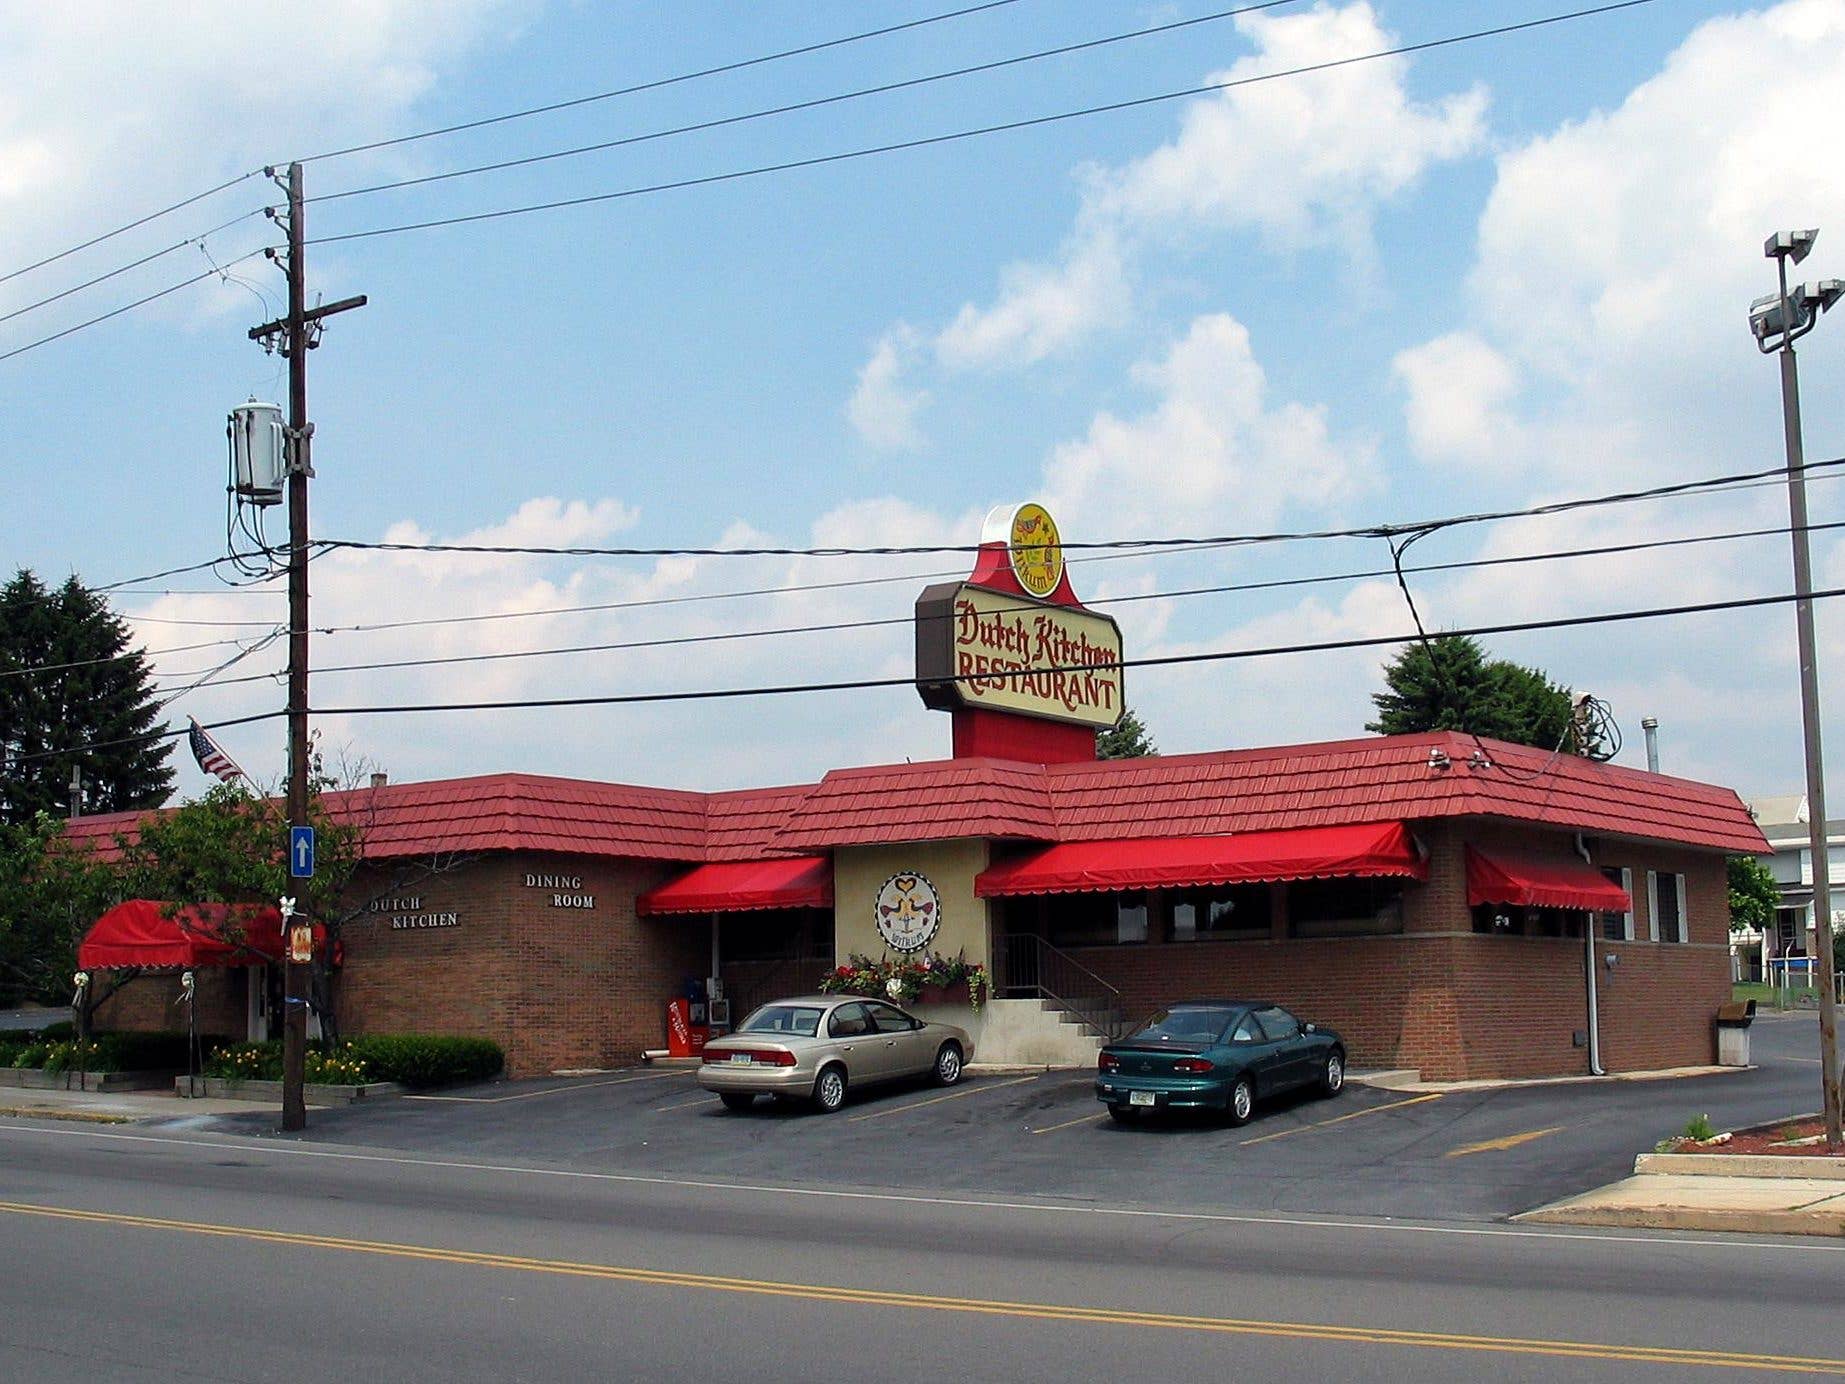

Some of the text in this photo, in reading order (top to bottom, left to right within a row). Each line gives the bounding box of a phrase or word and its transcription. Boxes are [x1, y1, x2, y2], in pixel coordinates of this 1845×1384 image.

[956, 598, 1116, 677] Dutch Kitchen
[958, 651, 1117, 712] RESTAURANT
[526, 874, 581, 889] DINING
[553, 894, 593, 908] ROOM
[392, 912, 457, 929] KITCHEN
